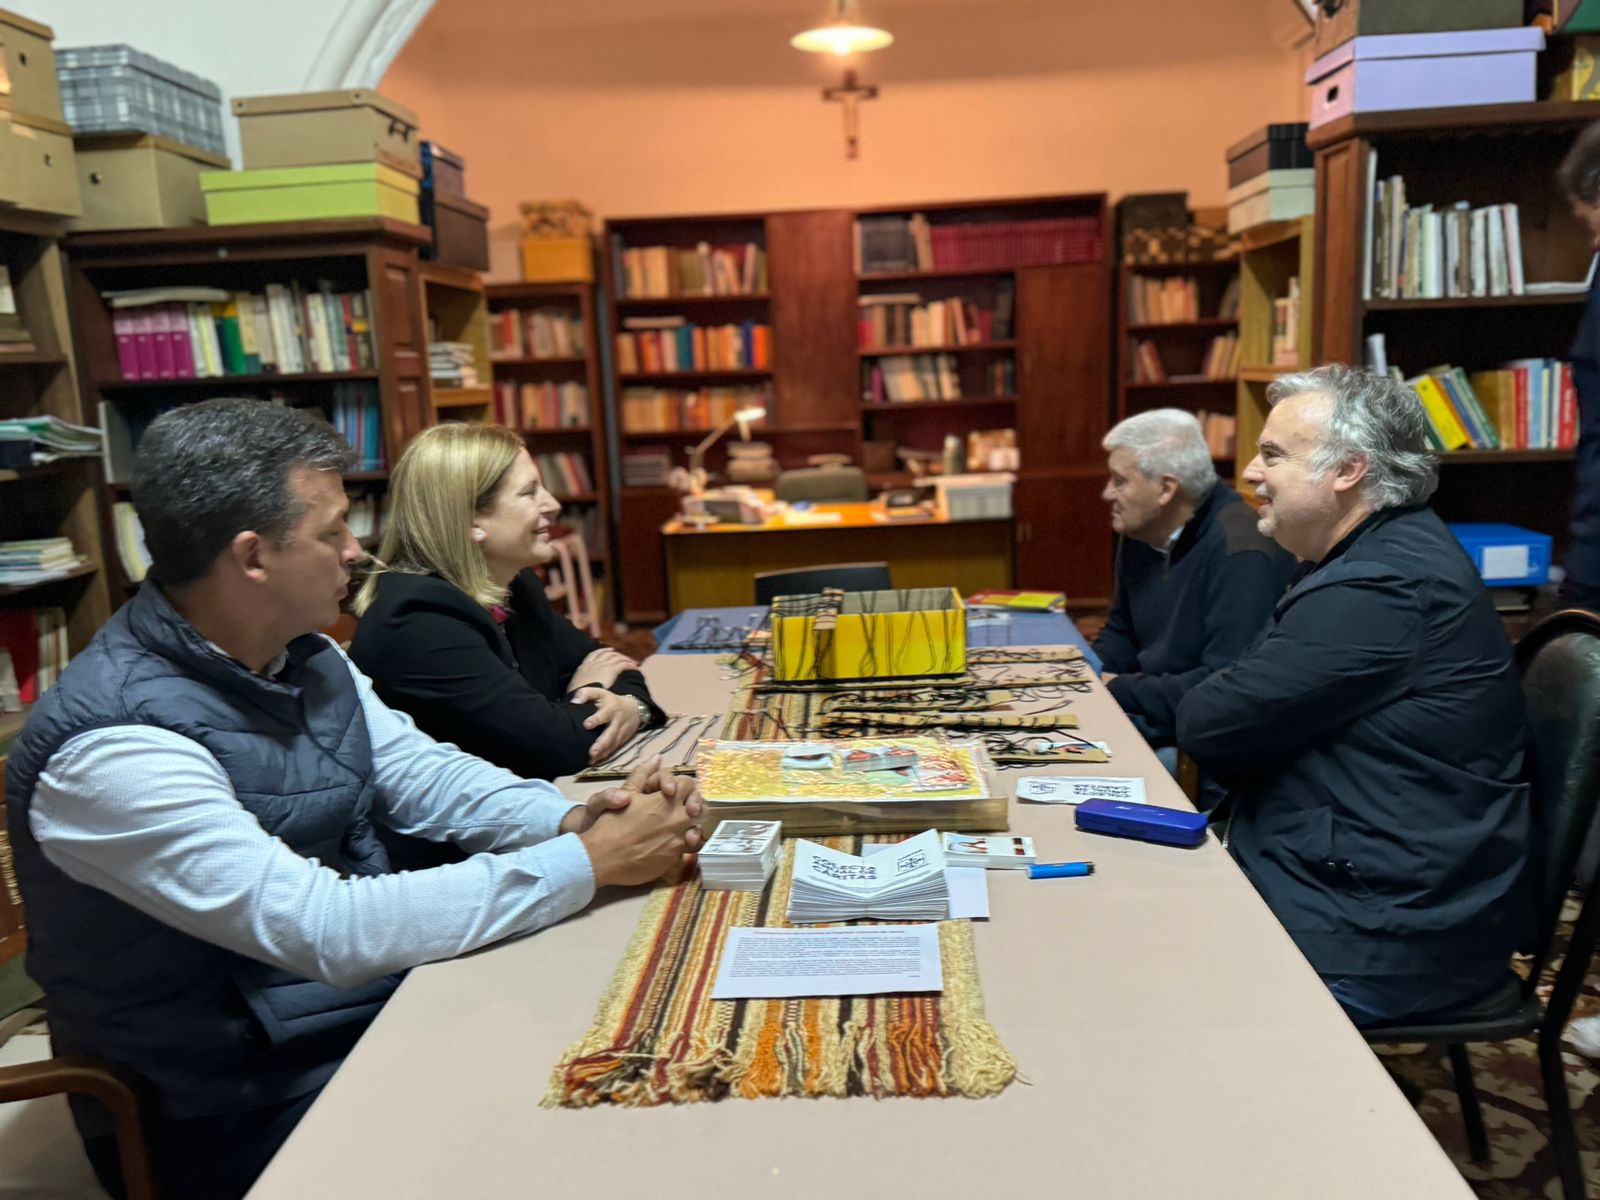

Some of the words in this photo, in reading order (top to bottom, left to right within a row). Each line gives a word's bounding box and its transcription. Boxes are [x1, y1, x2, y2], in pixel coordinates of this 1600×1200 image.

[812, 856, 877, 870] COLECTA
[812, 861, 857, 874] ANUAL
[812, 865, 877, 879] CARITAS
